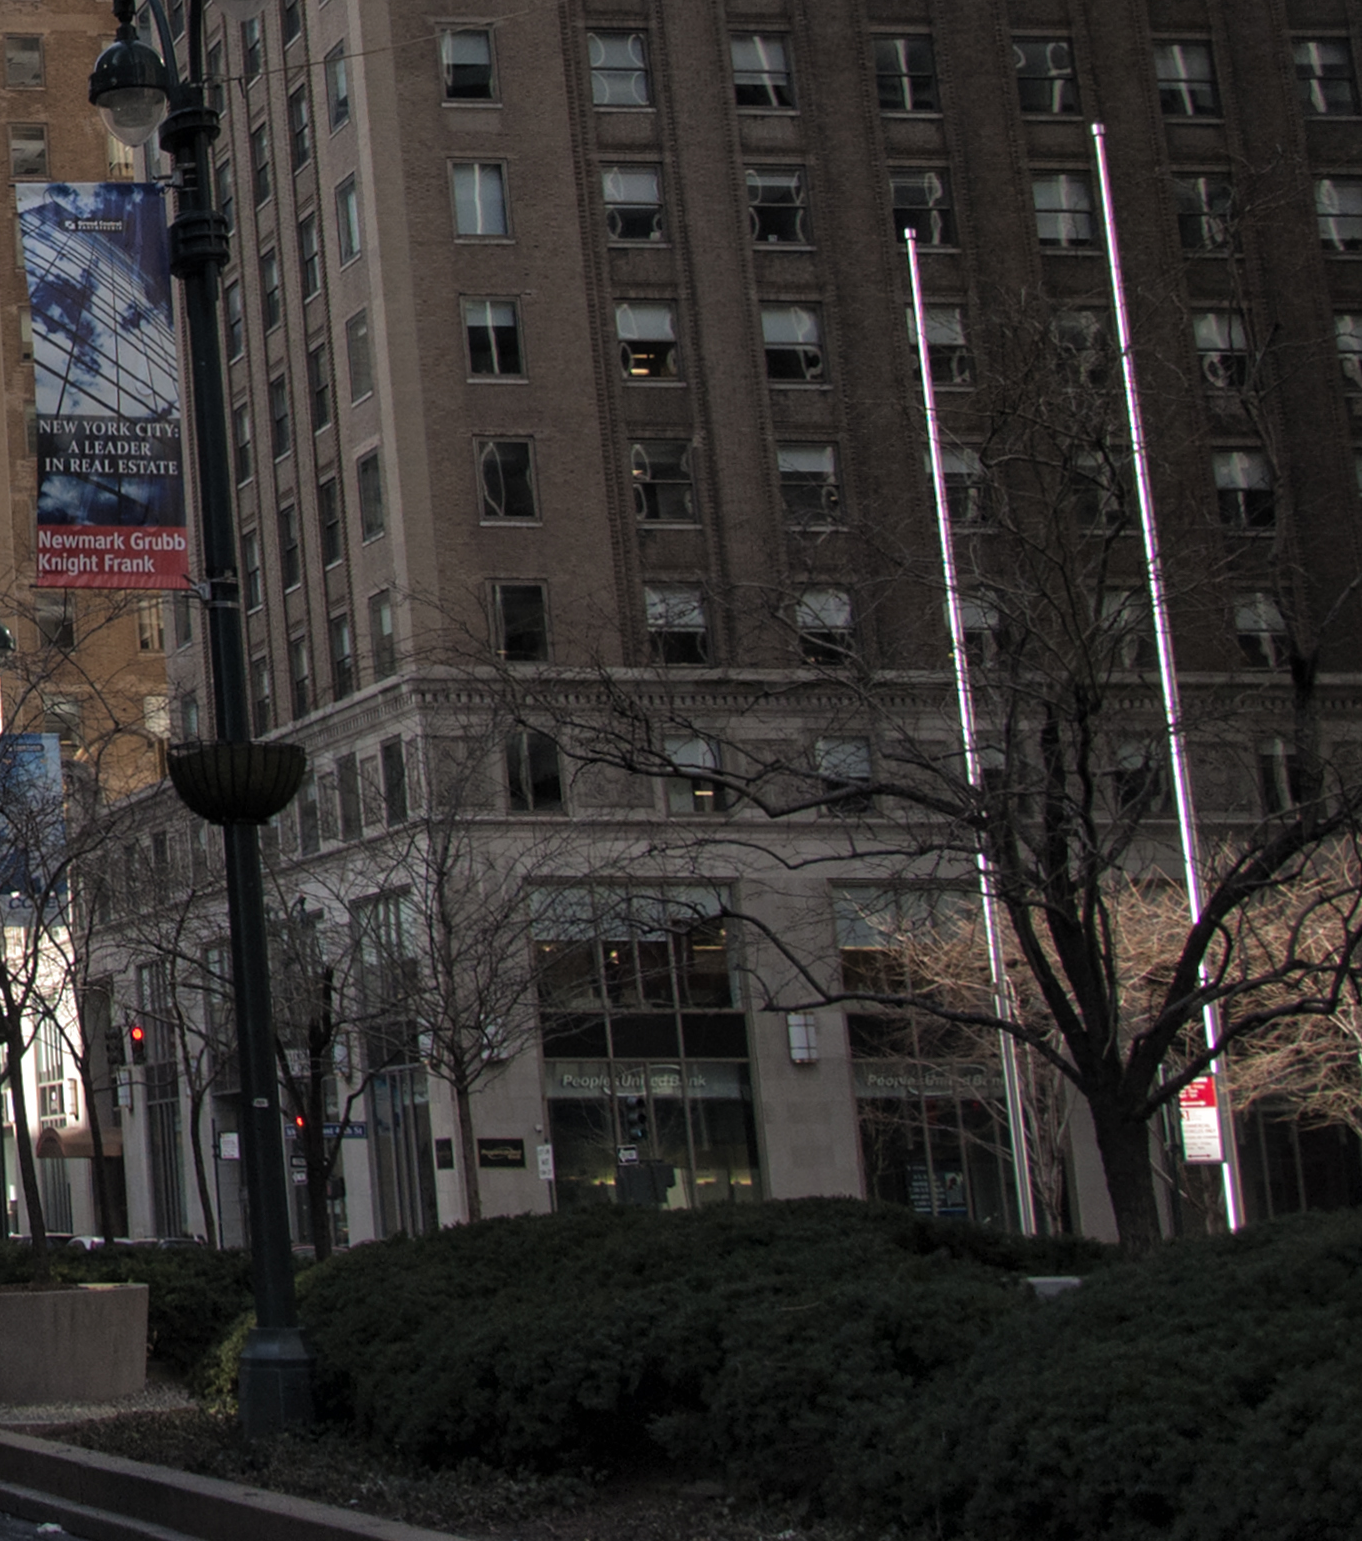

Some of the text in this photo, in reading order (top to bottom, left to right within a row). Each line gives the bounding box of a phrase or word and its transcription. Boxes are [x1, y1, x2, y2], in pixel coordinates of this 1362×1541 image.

[39, 420, 179, 438] NEW YORK CITY:
[68, 440, 152, 456] A LEADER
[45, 458, 178, 475] IN REAL ESTATE
[38, 530, 186, 551] Newmark Grubb
[38, 553, 155, 576] Knight Frank
[622, 1074, 667, 1087] Unied
[670, 1074, 707, 1086] Bnk
